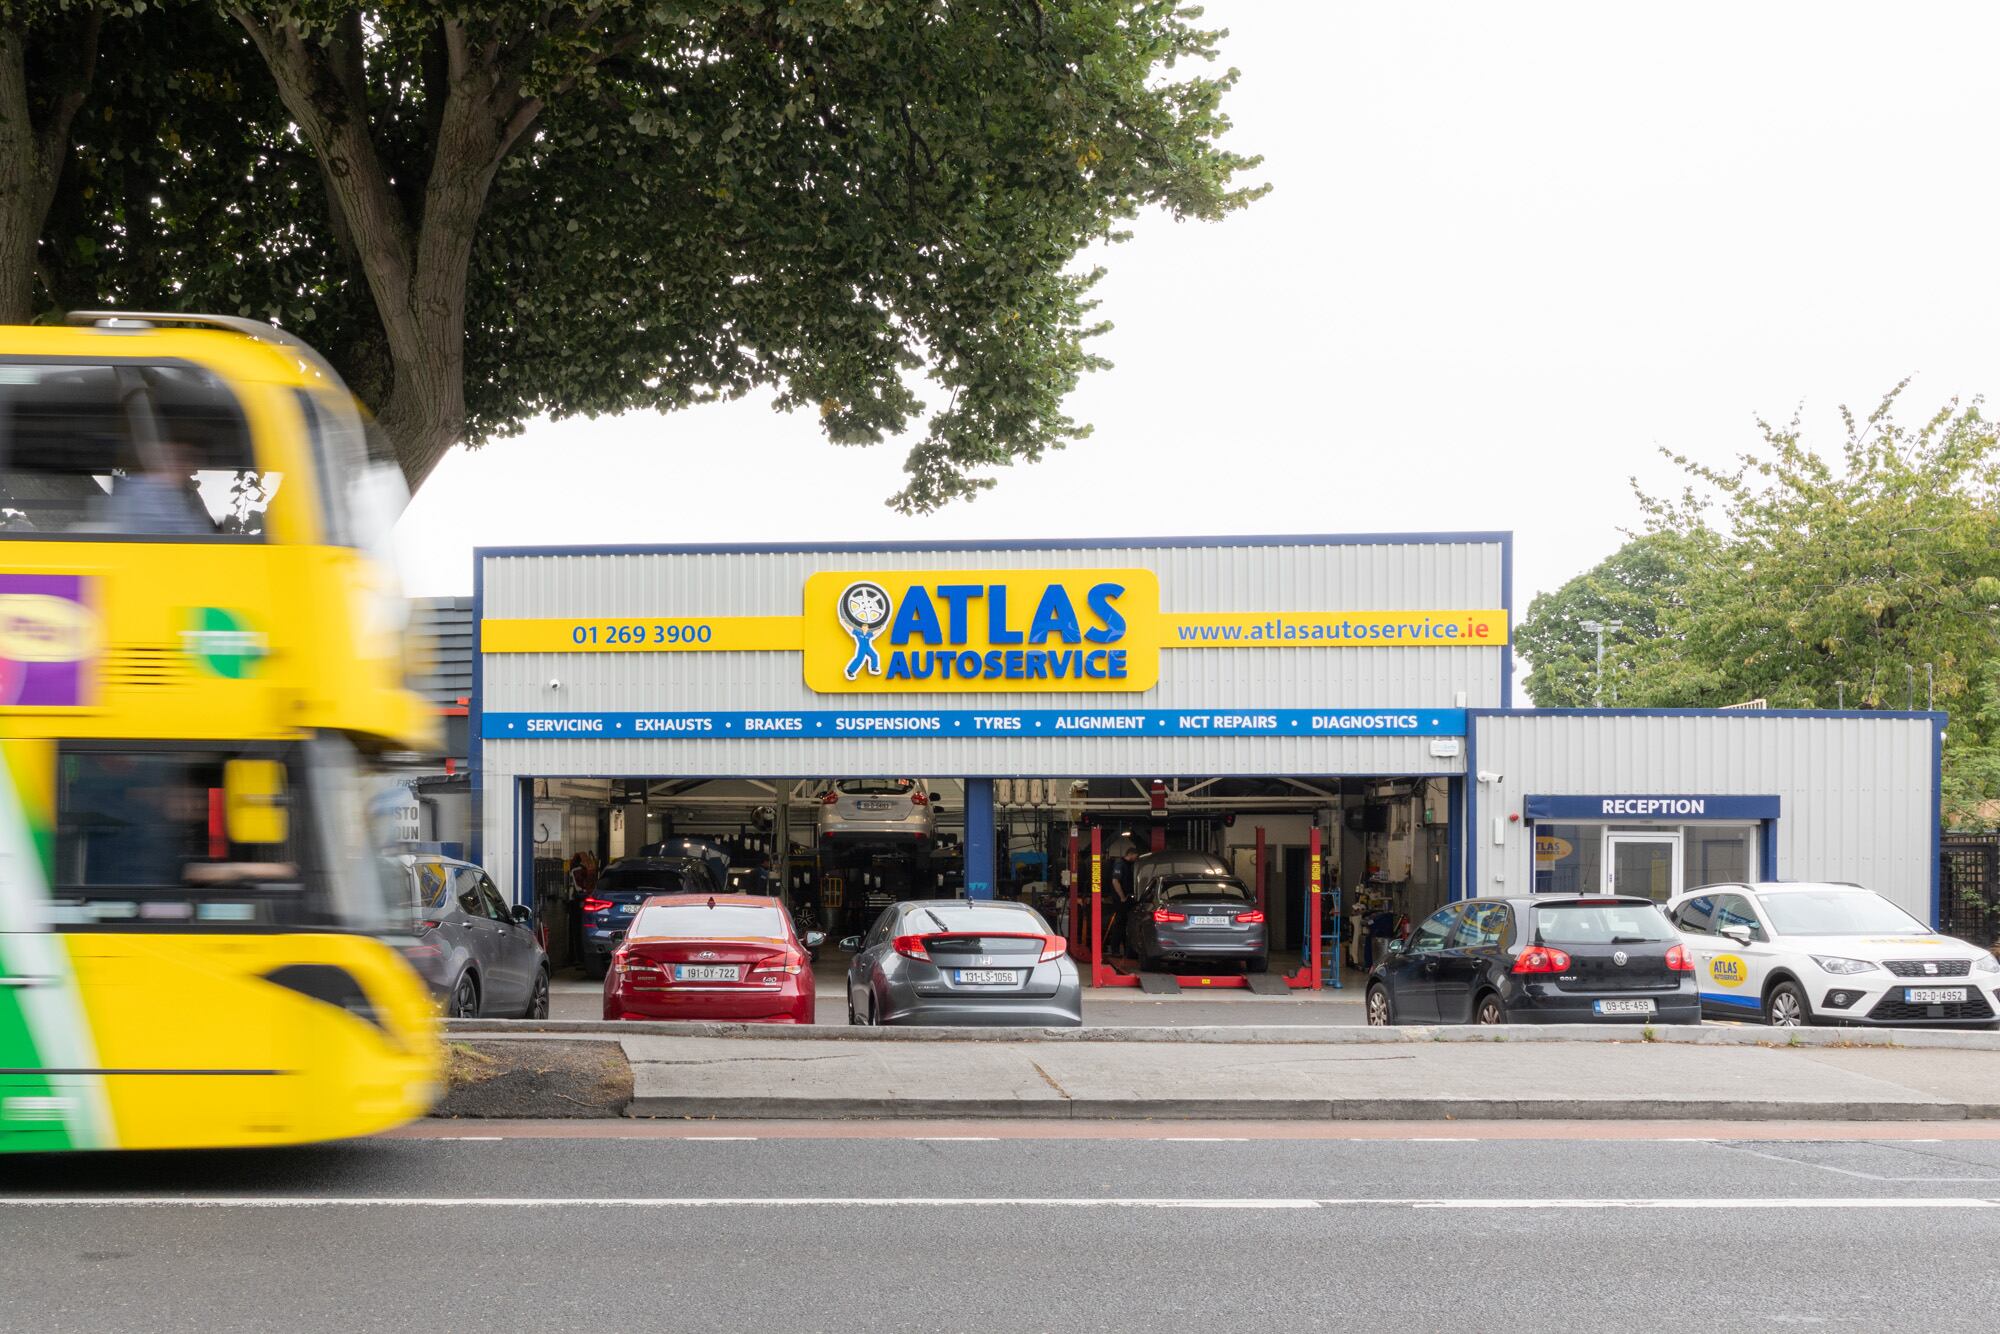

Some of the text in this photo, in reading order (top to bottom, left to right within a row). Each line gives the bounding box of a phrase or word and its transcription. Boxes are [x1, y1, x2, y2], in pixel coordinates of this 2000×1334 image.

[890, 583, 1127, 645] ATLAS
[572, 624, 712, 644] 01 269 3900
[1177, 617, 1489, 640] www.atlasautoservice.ie
[886, 649, 1127, 680] AUTOSERVICE
[527, 716, 1418, 732] SERVICING EXHAUSTS BRAKES SUSPENSIONS TYRES ALIGNMENT NCT REPAIRS DIAGNOSTICS
[1602, 799, 1705, 814] RECEPTION
[1714, 961, 1738, 974] ATLAS
[965, 972, 1013, 982] 131-LS-1056
[1914, 991, 1963, 1001] 192-D-14952
[1605, 1001, 1649, 1011] 09-CE-459
